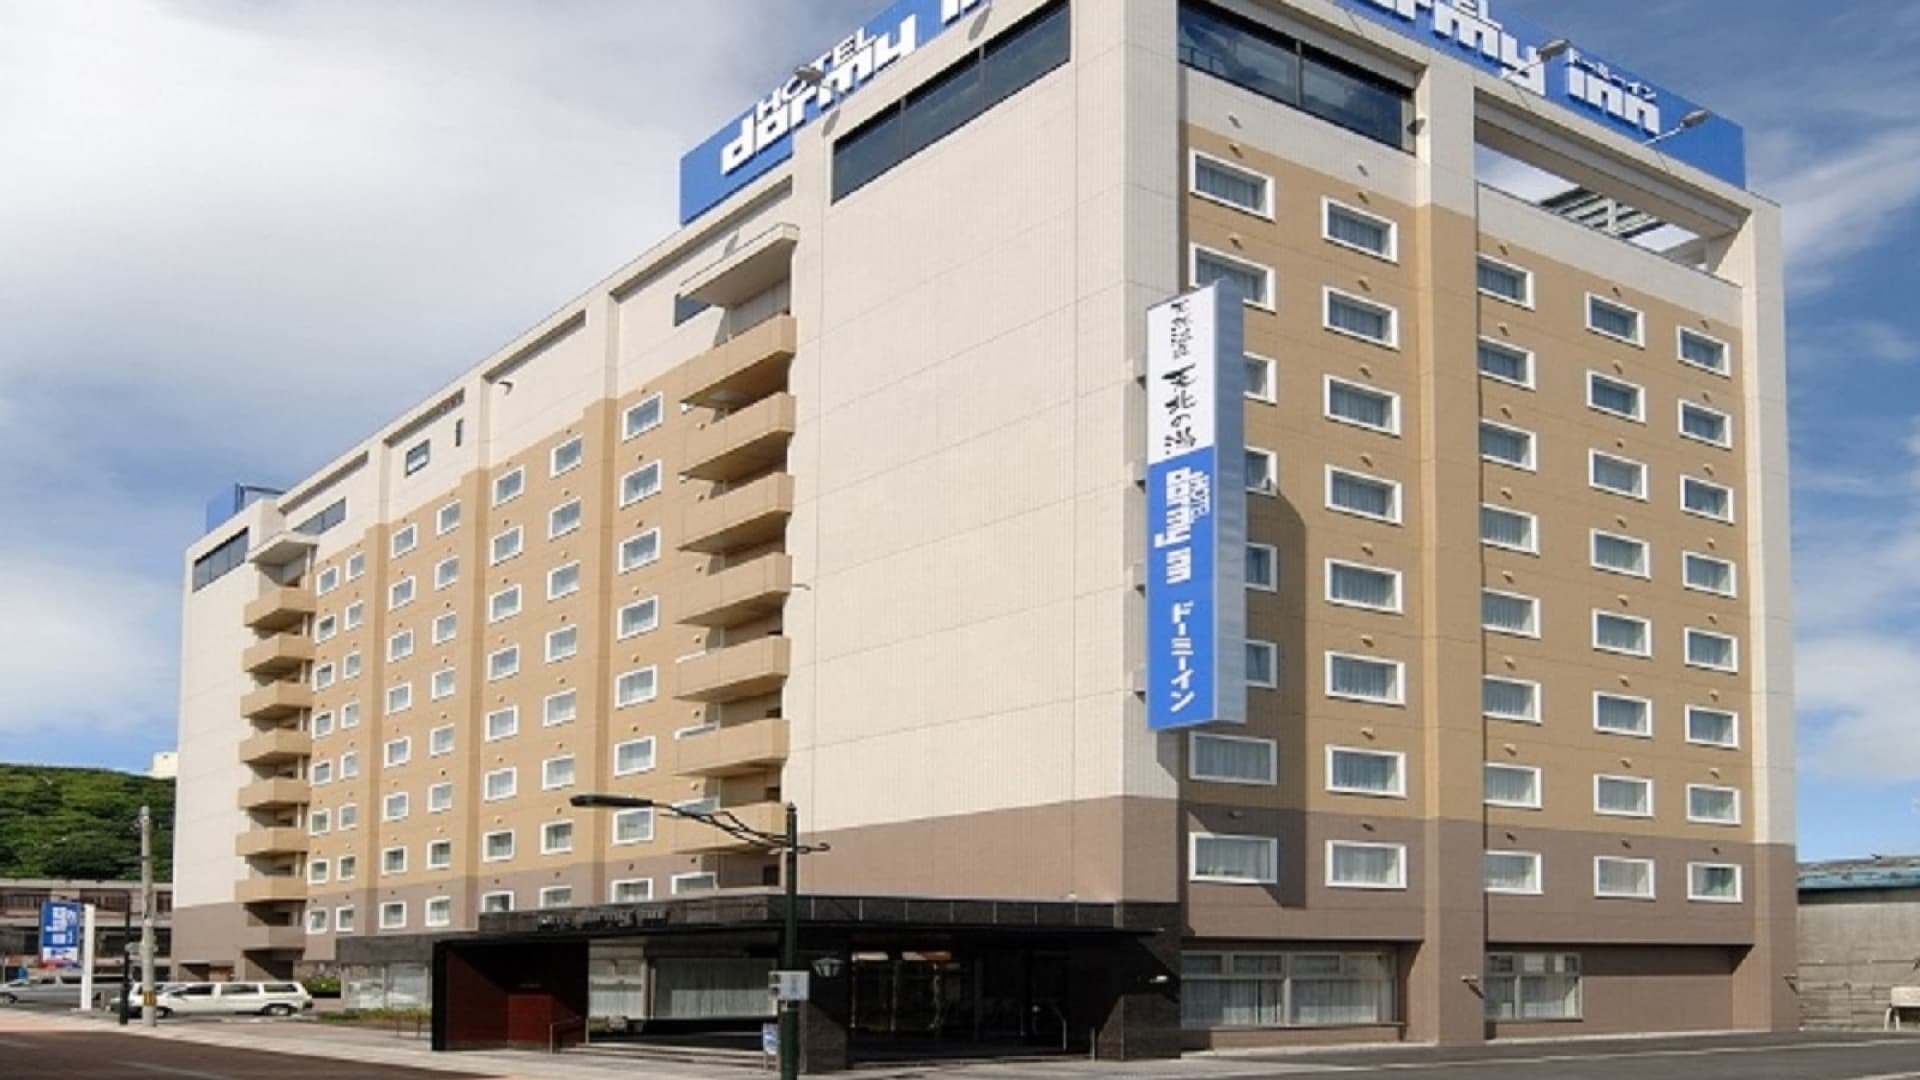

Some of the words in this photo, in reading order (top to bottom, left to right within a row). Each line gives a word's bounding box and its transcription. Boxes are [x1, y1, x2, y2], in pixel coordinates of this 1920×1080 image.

[721, 14, 917, 176] dormy
[1568, 66, 1660, 134] inn
[1170, 601, 1195, 712] ドーミーイン
